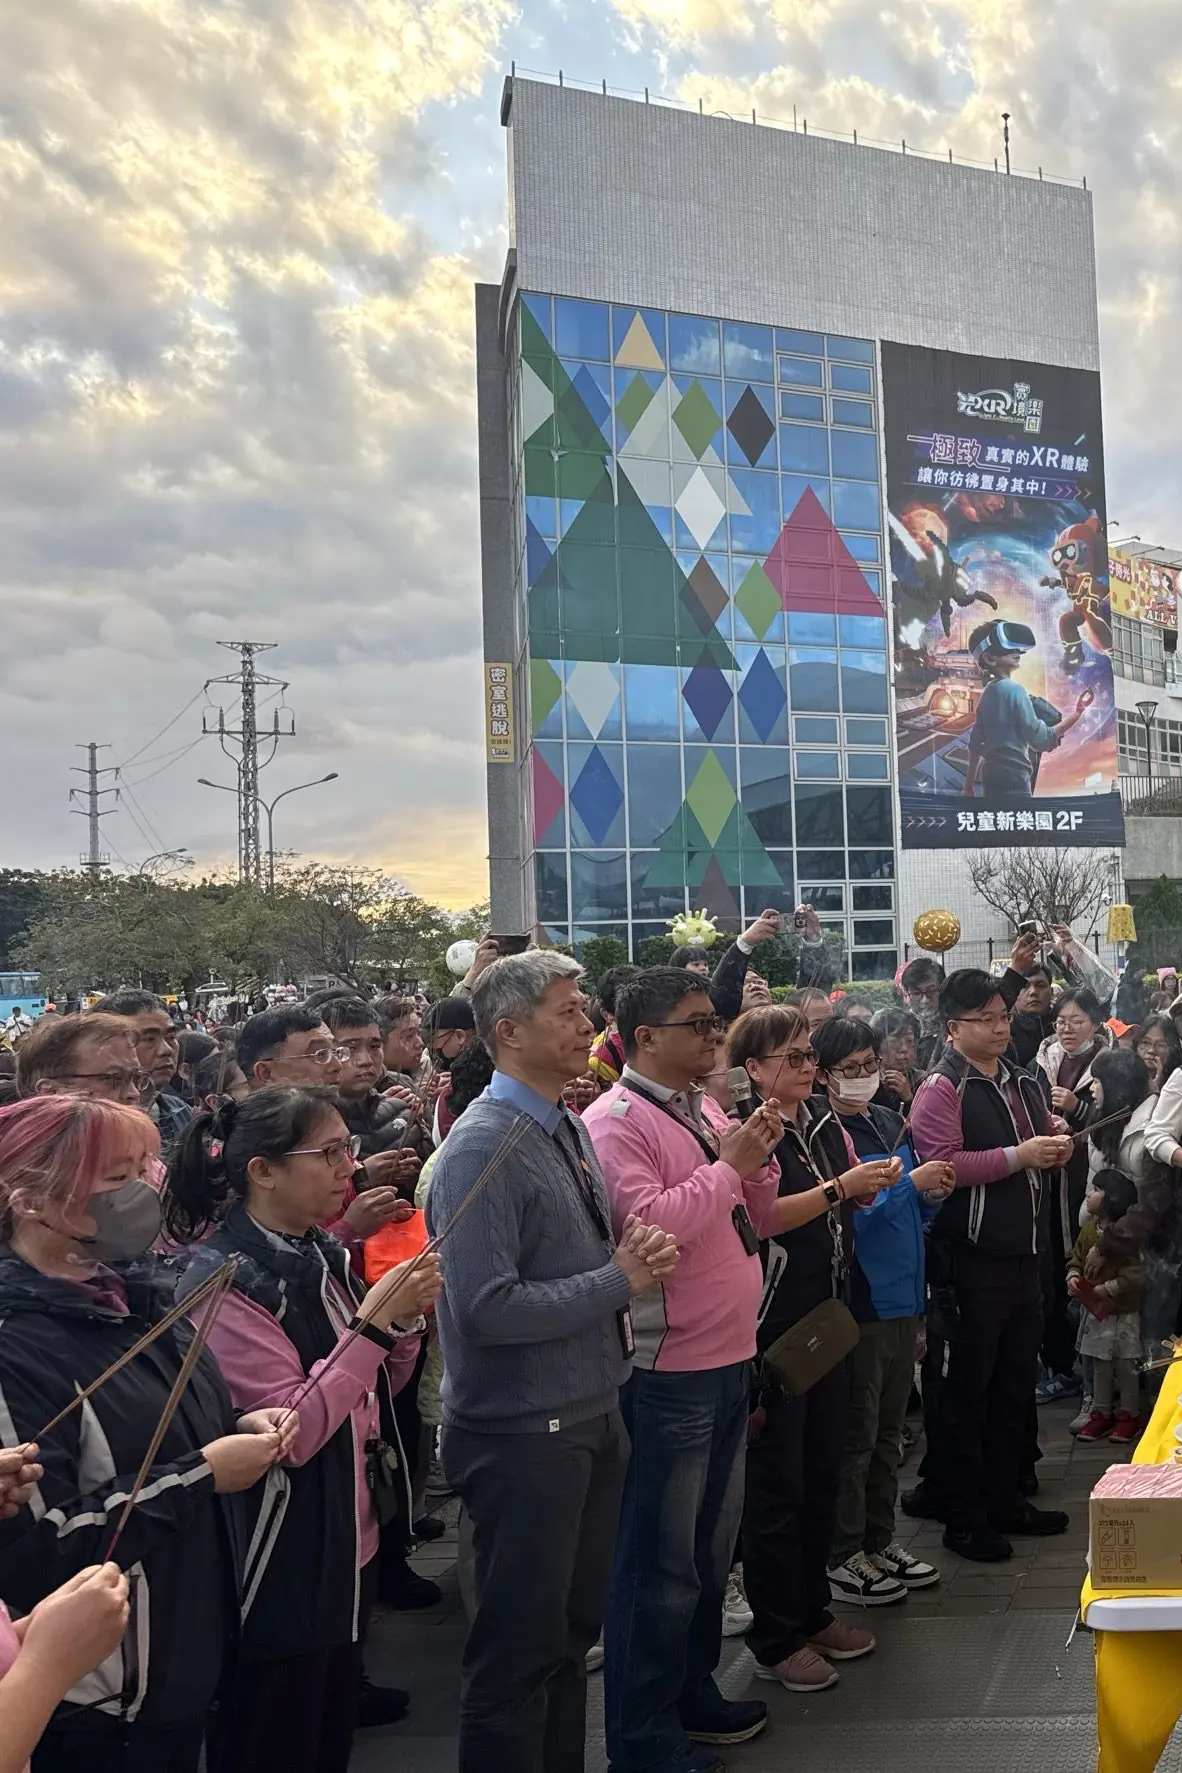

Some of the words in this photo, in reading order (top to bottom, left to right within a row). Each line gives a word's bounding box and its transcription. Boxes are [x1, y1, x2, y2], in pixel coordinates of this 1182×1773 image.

[985, 445, 1090, 472] 真實的XR體驗
[1146, 609, 1168, 624] ALL
[490, 667, 508, 735] 密室逃脫
[957, 811, 1083, 831] 兒童新樂園2F
